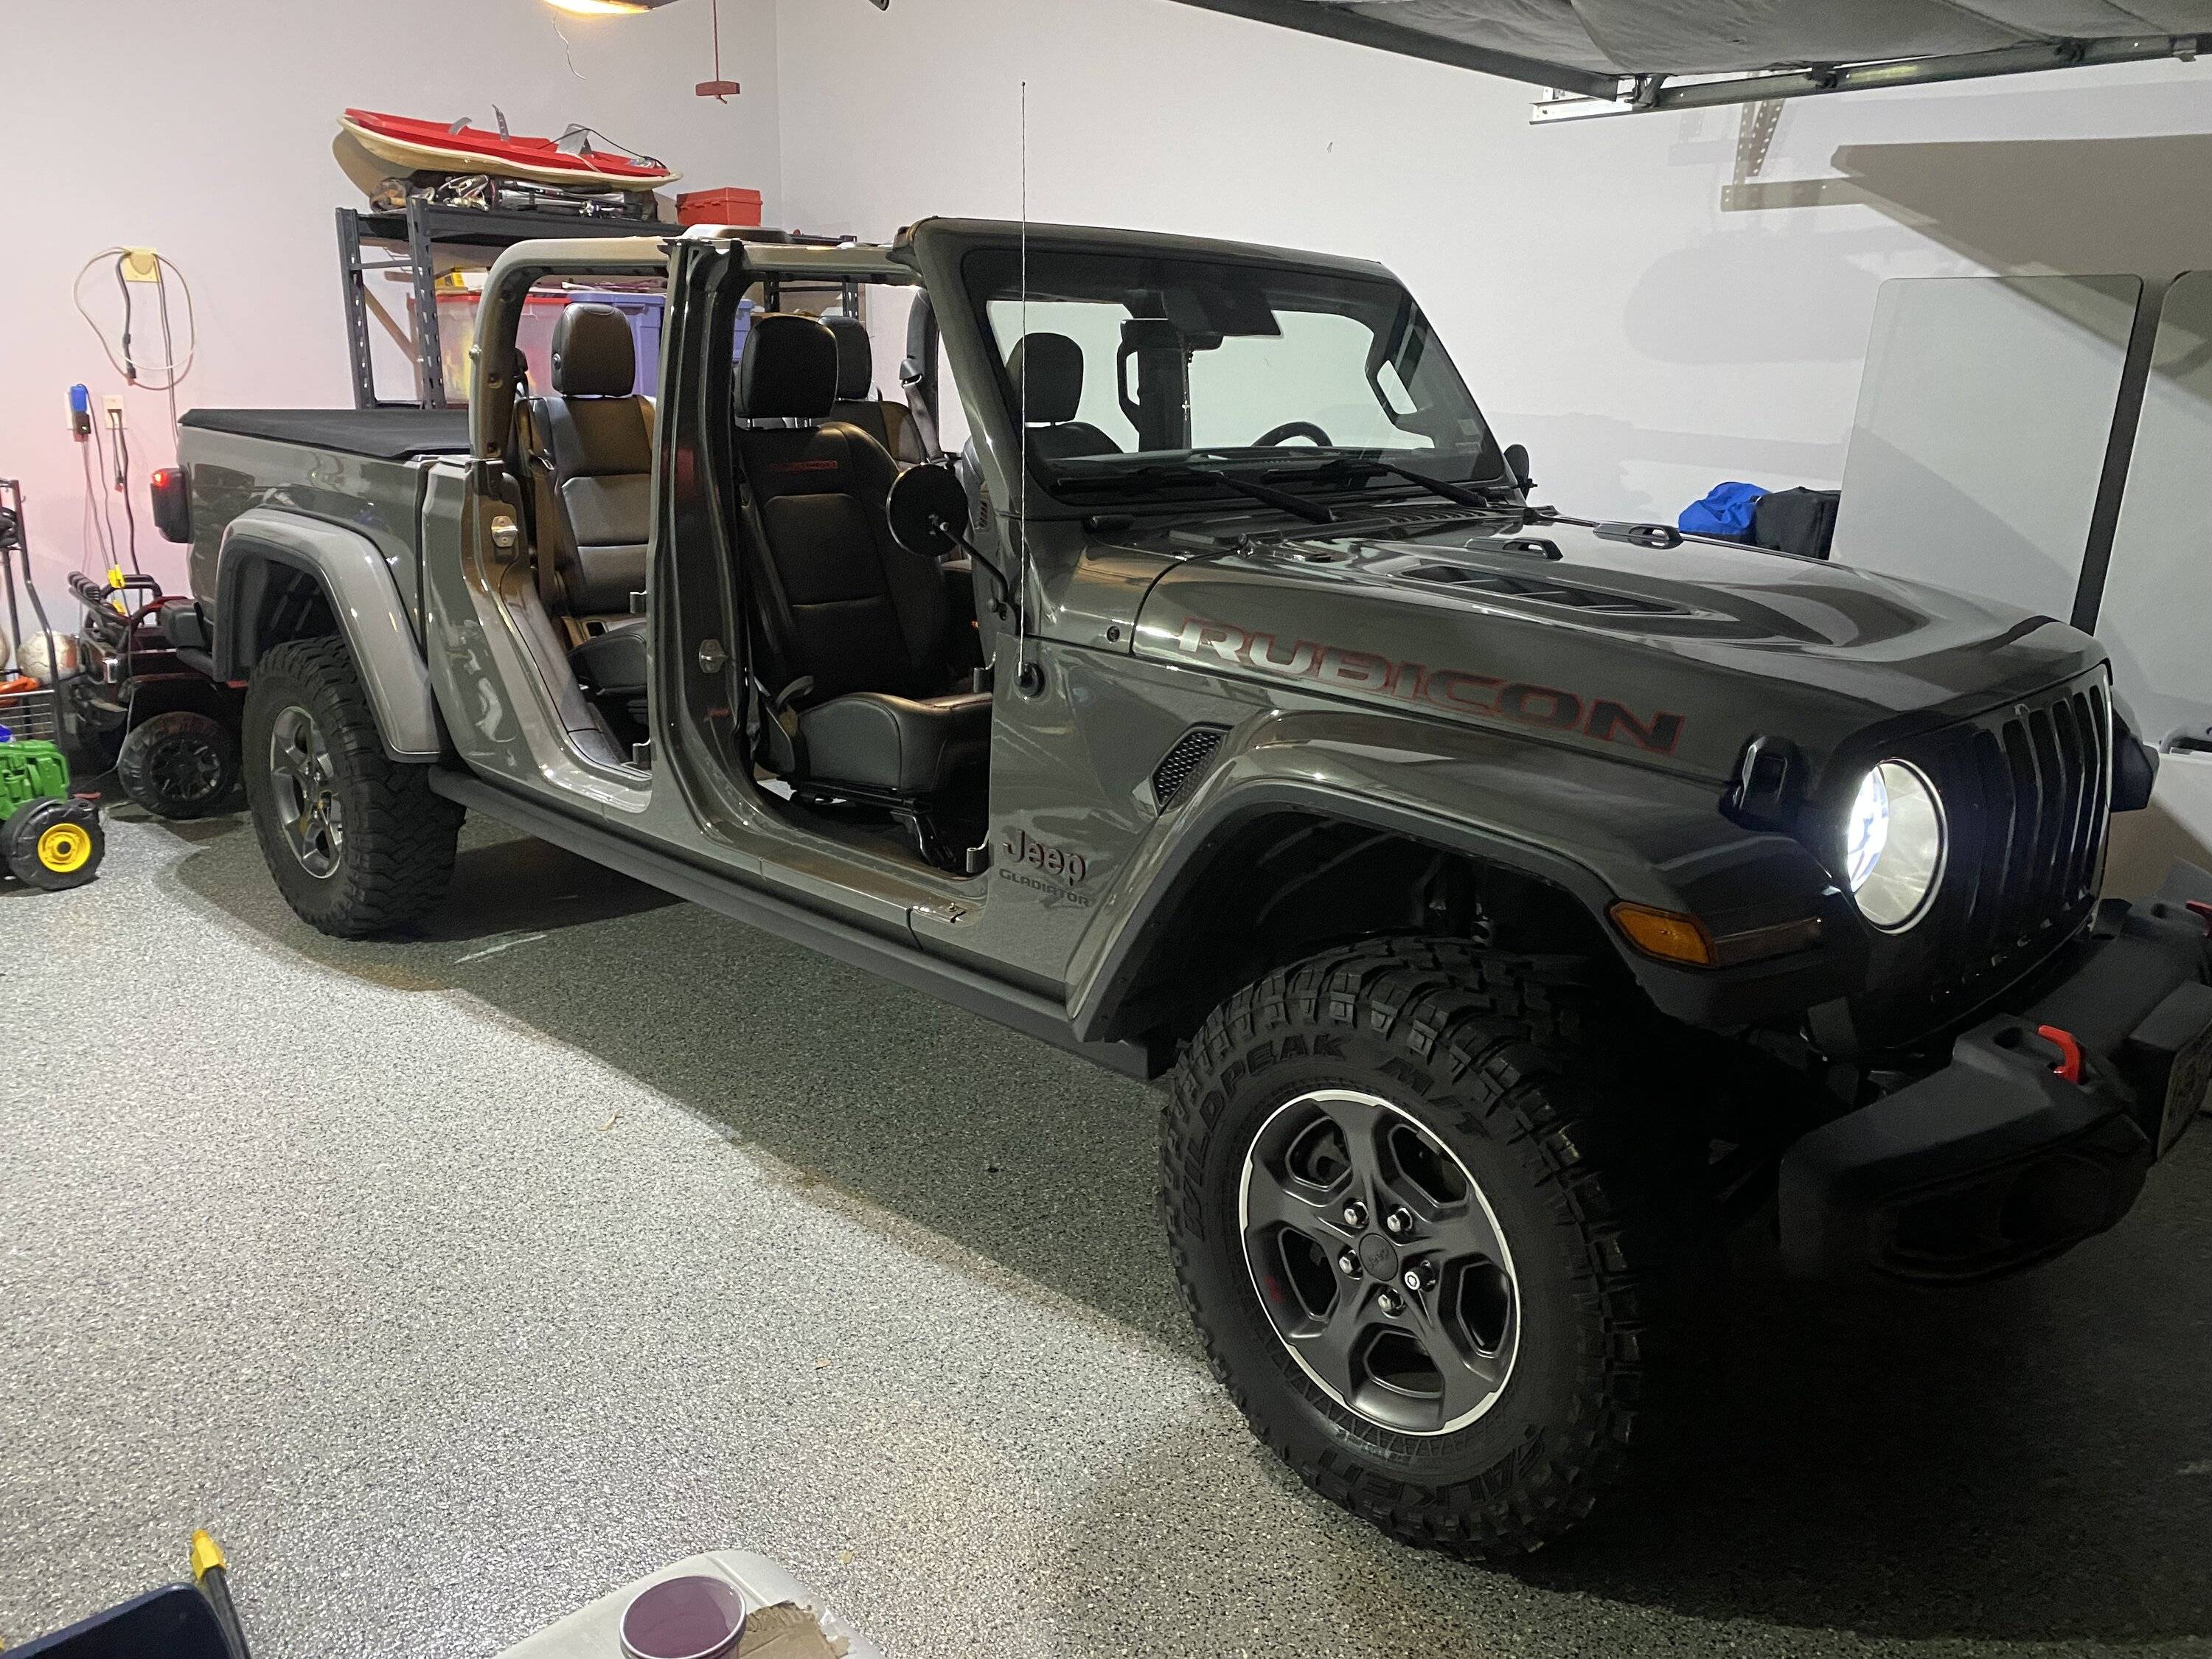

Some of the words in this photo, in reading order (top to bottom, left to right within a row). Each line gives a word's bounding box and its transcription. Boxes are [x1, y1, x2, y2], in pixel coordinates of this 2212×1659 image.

[1179, 616, 1686, 755] RUBICON
[999, 869, 1090, 907] GLADIATOR
[1002, 829, 1086, 886] Jeep
[1182, 1034, 1351, 1240] WILDPEAK
